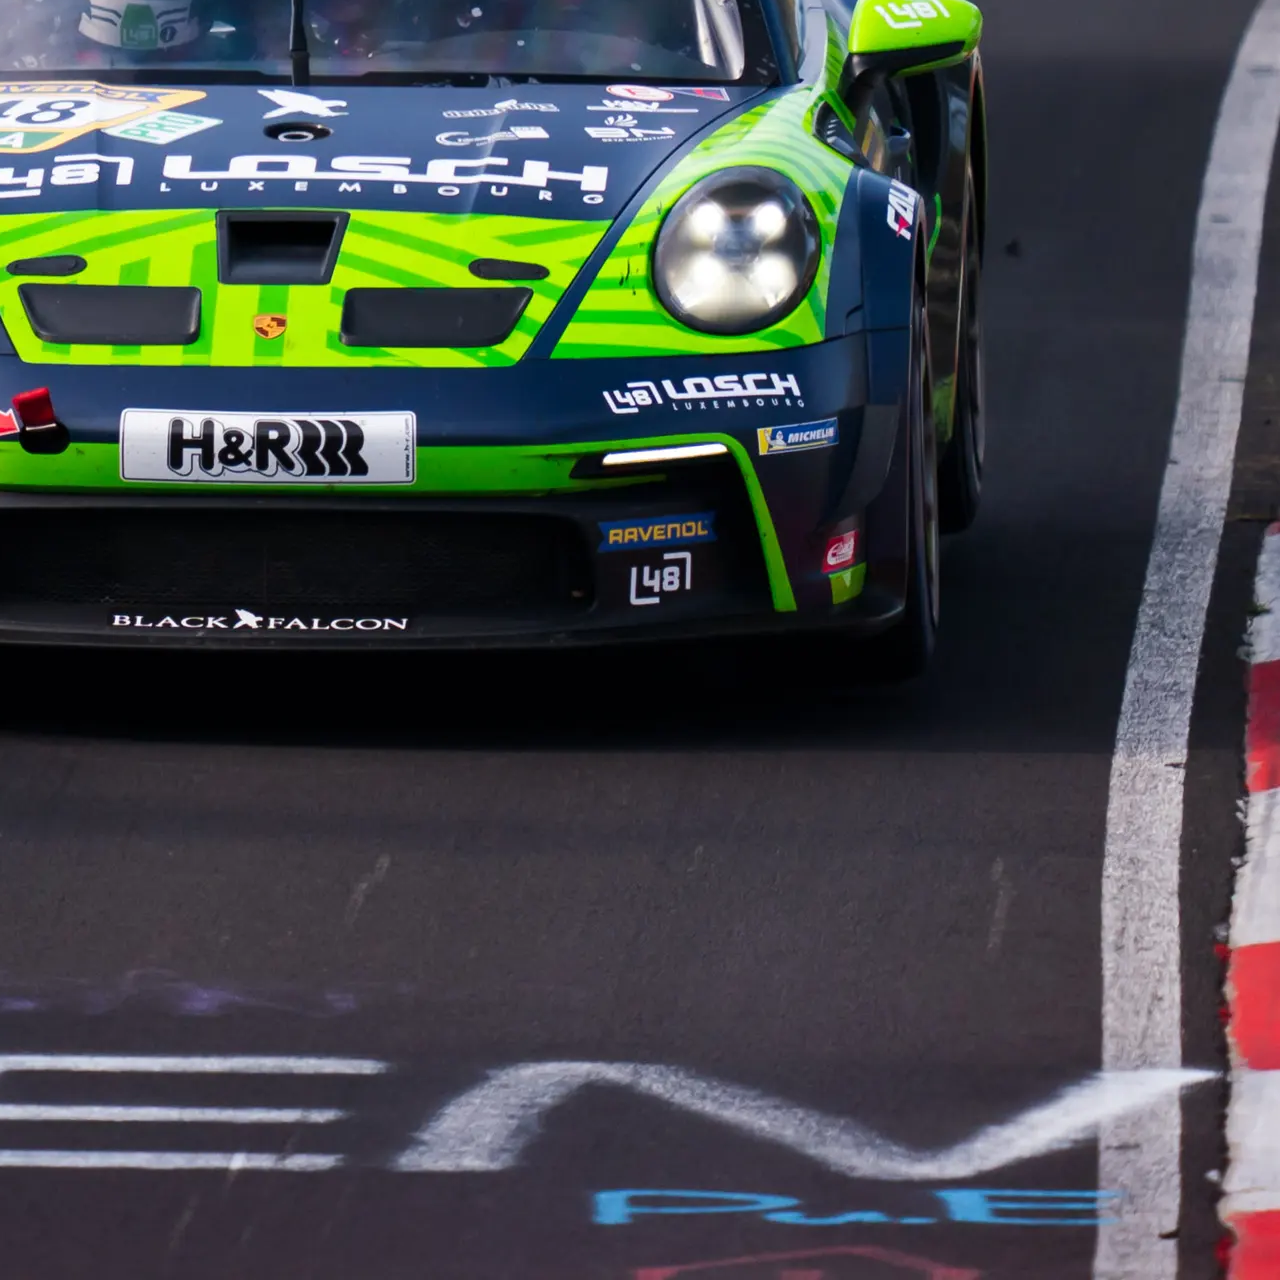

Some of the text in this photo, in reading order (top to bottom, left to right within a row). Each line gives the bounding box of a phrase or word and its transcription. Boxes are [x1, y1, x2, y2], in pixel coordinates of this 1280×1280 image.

[163, 154, 608, 192] LOSCH
[160, 180, 604, 206] LUXEMBOURG
[661, 373, 802, 399] LOSCH
[672, 396, 805, 412] LUXEMBOURG
[167, 418, 306, 476] H&R
[788, 426, 835, 444] MICHELIN
[608, 521, 709, 544] RAVENOL
[112, 614, 408, 629] BLACK FALCON
